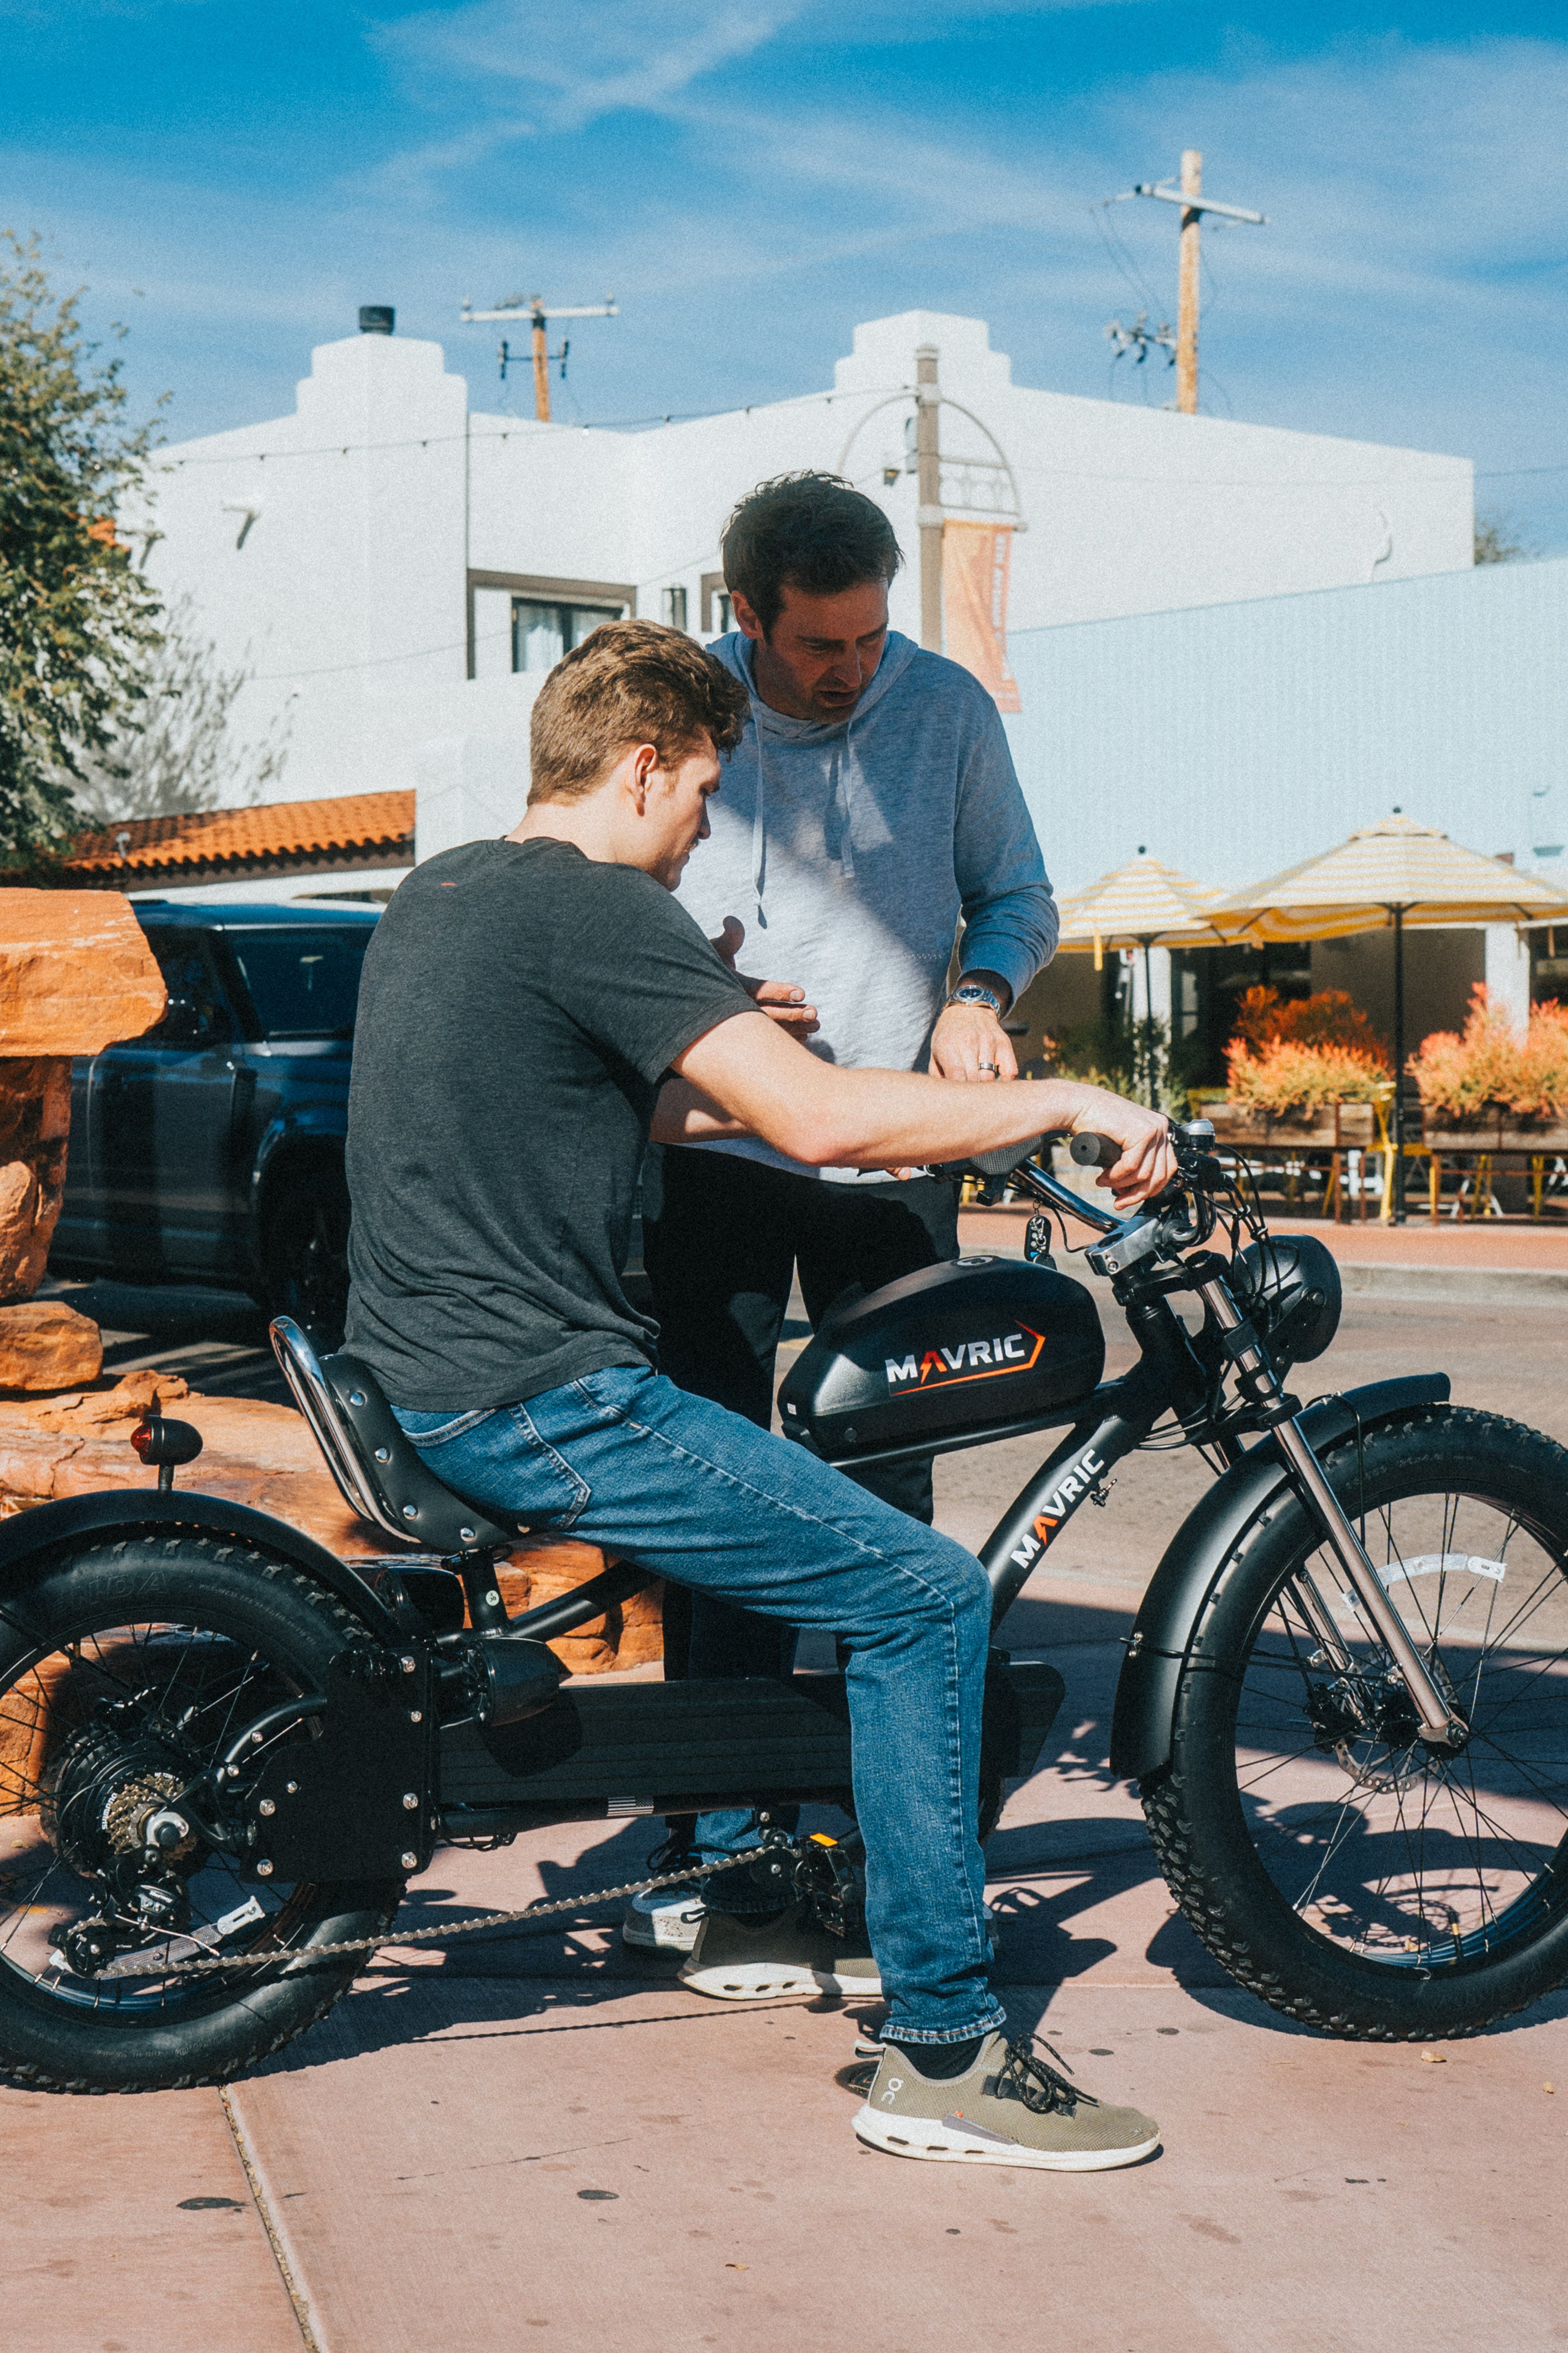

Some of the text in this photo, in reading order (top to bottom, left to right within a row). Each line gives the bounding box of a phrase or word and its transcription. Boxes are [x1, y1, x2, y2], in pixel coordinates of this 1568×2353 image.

[885, 1333, 1025, 1384] MAVRIC
[1010, 1448, 1104, 1569] MAVRIC
[102, 1792, 118, 1830] SHIMANO
